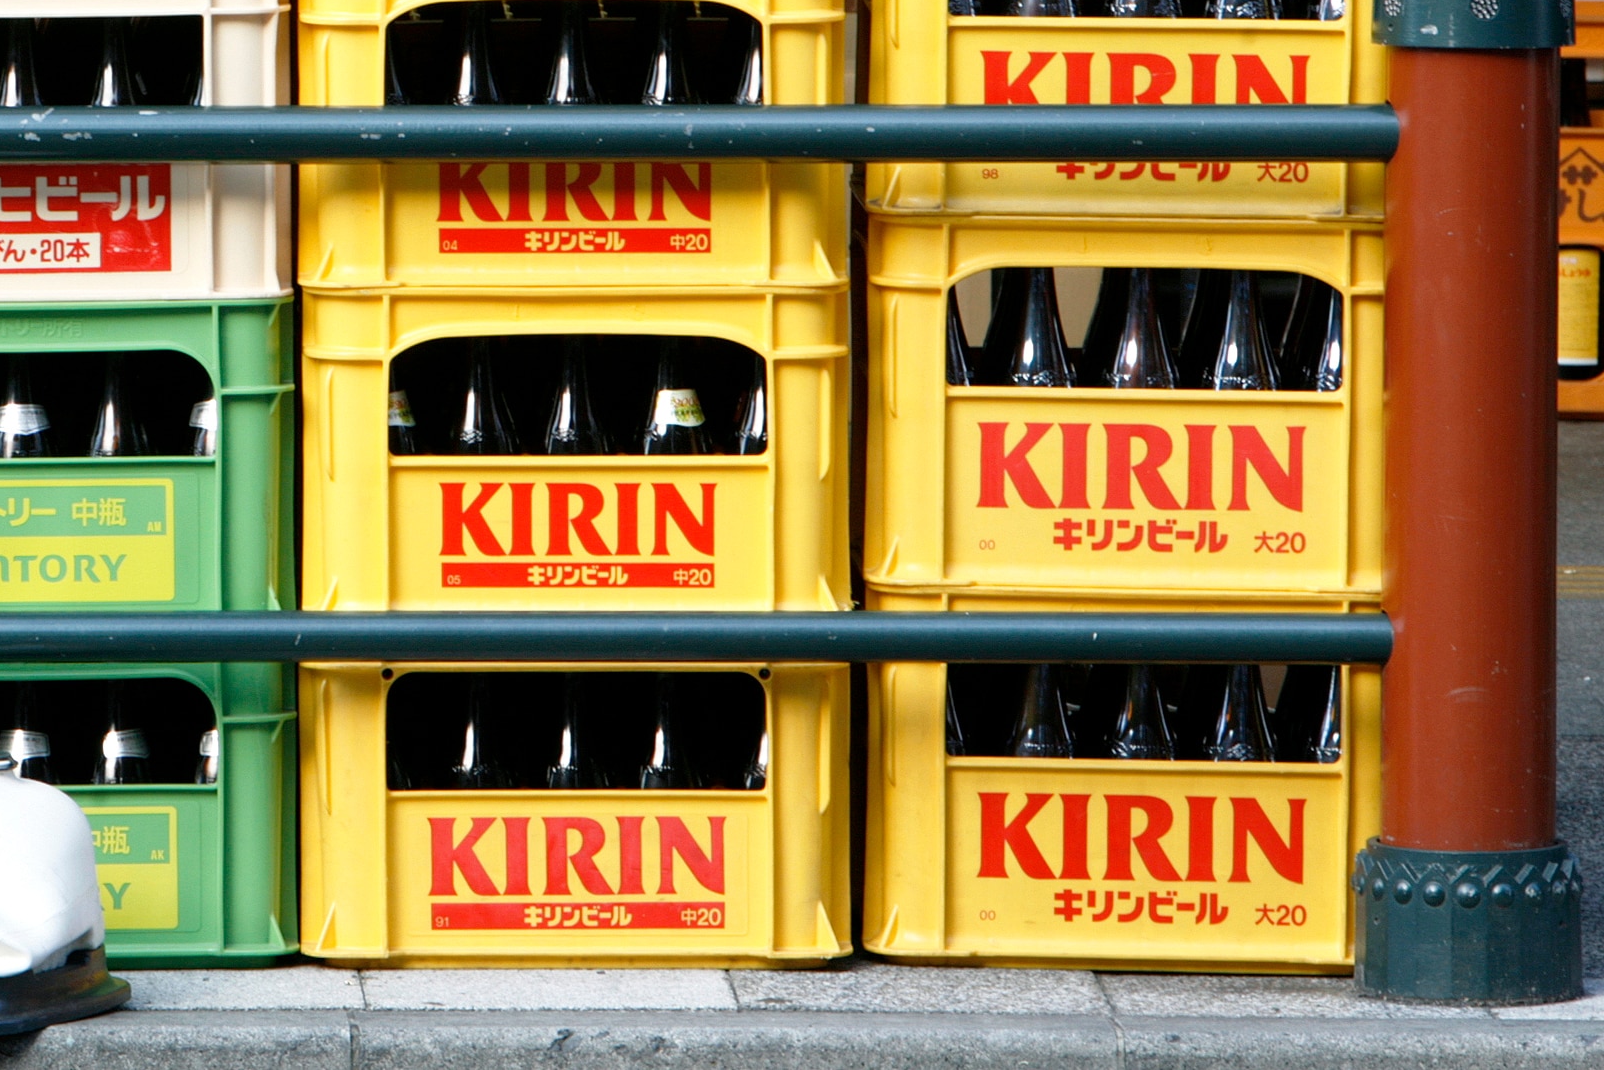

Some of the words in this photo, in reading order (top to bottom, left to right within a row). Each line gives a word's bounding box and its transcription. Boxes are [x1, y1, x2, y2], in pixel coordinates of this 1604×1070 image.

[980, 50, 1310, 104] KIRIN
[436, 162, 711, 222] KIRIN
[524, 230, 626, 251] キリンビール
[976, 422, 1306, 512] KIRIN
[72, 497, 127, 526] 中瓶
[439, 482, 718, 557] KIRIN
[1053, 518, 1228, 553] キリンビール
[527, 565, 628, 586] キリンビール
[427, 816, 727, 896] KIRIN
[976, 792, 1307, 885] KIRIN
[524, 905, 632, 927] キリンビール
[1054, 889, 1229, 925] キリンビール
